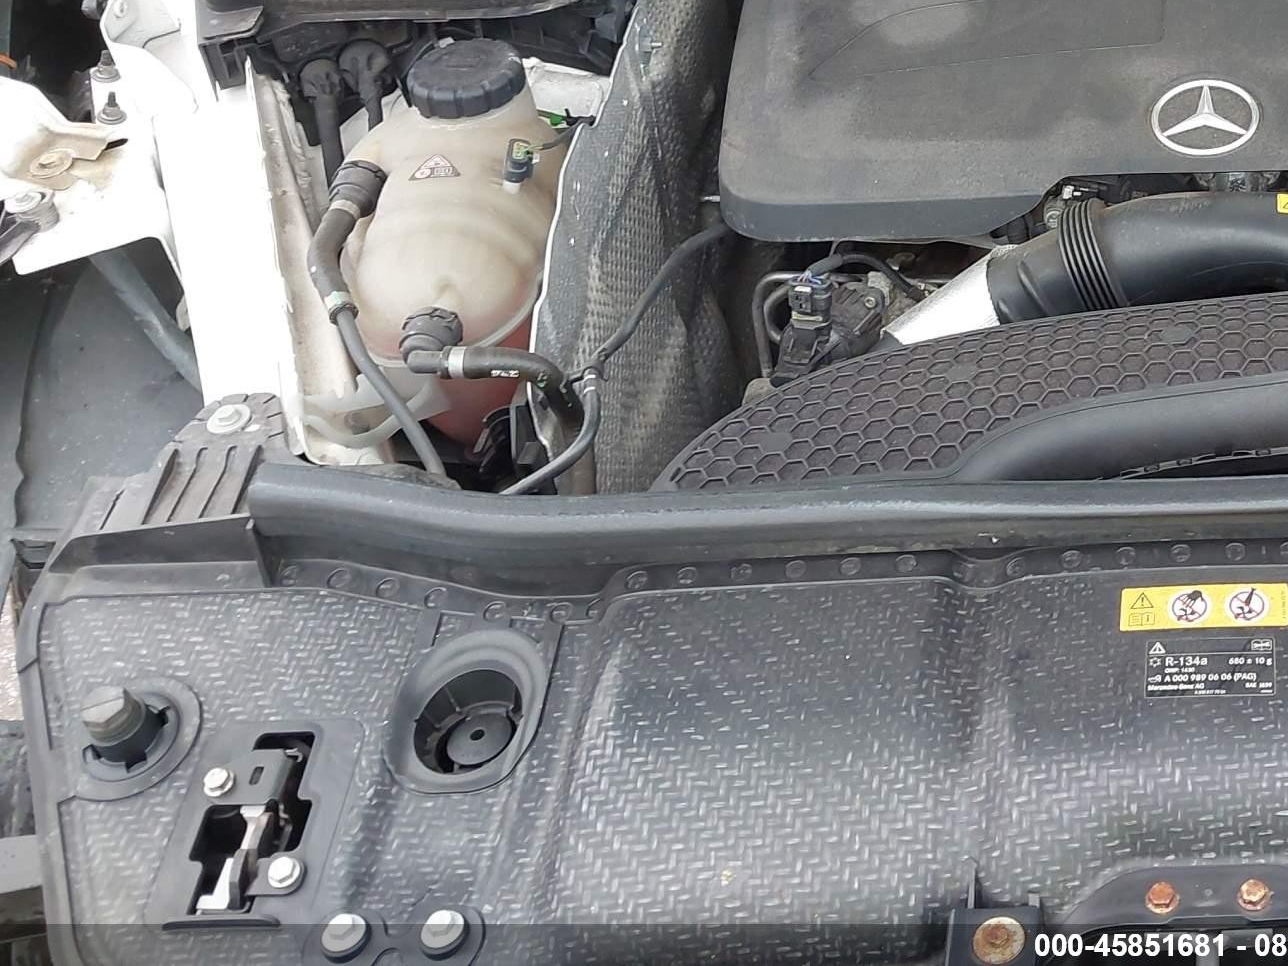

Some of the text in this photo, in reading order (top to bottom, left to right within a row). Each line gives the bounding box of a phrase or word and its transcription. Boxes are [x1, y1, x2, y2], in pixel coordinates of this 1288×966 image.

[1165, 656, 1208, 667] R-134a
[1228, 657, 1245, 665] 680
[1255, 656, 1265, 664] 10
[1164, 675, 1171, 683] A
[1172, 674, 1189, 682] 000
[1208, 673, 1219, 681] 06
[1221, 673, 1232, 681] 06
[1234, 672, 1257, 682] (PAG)
